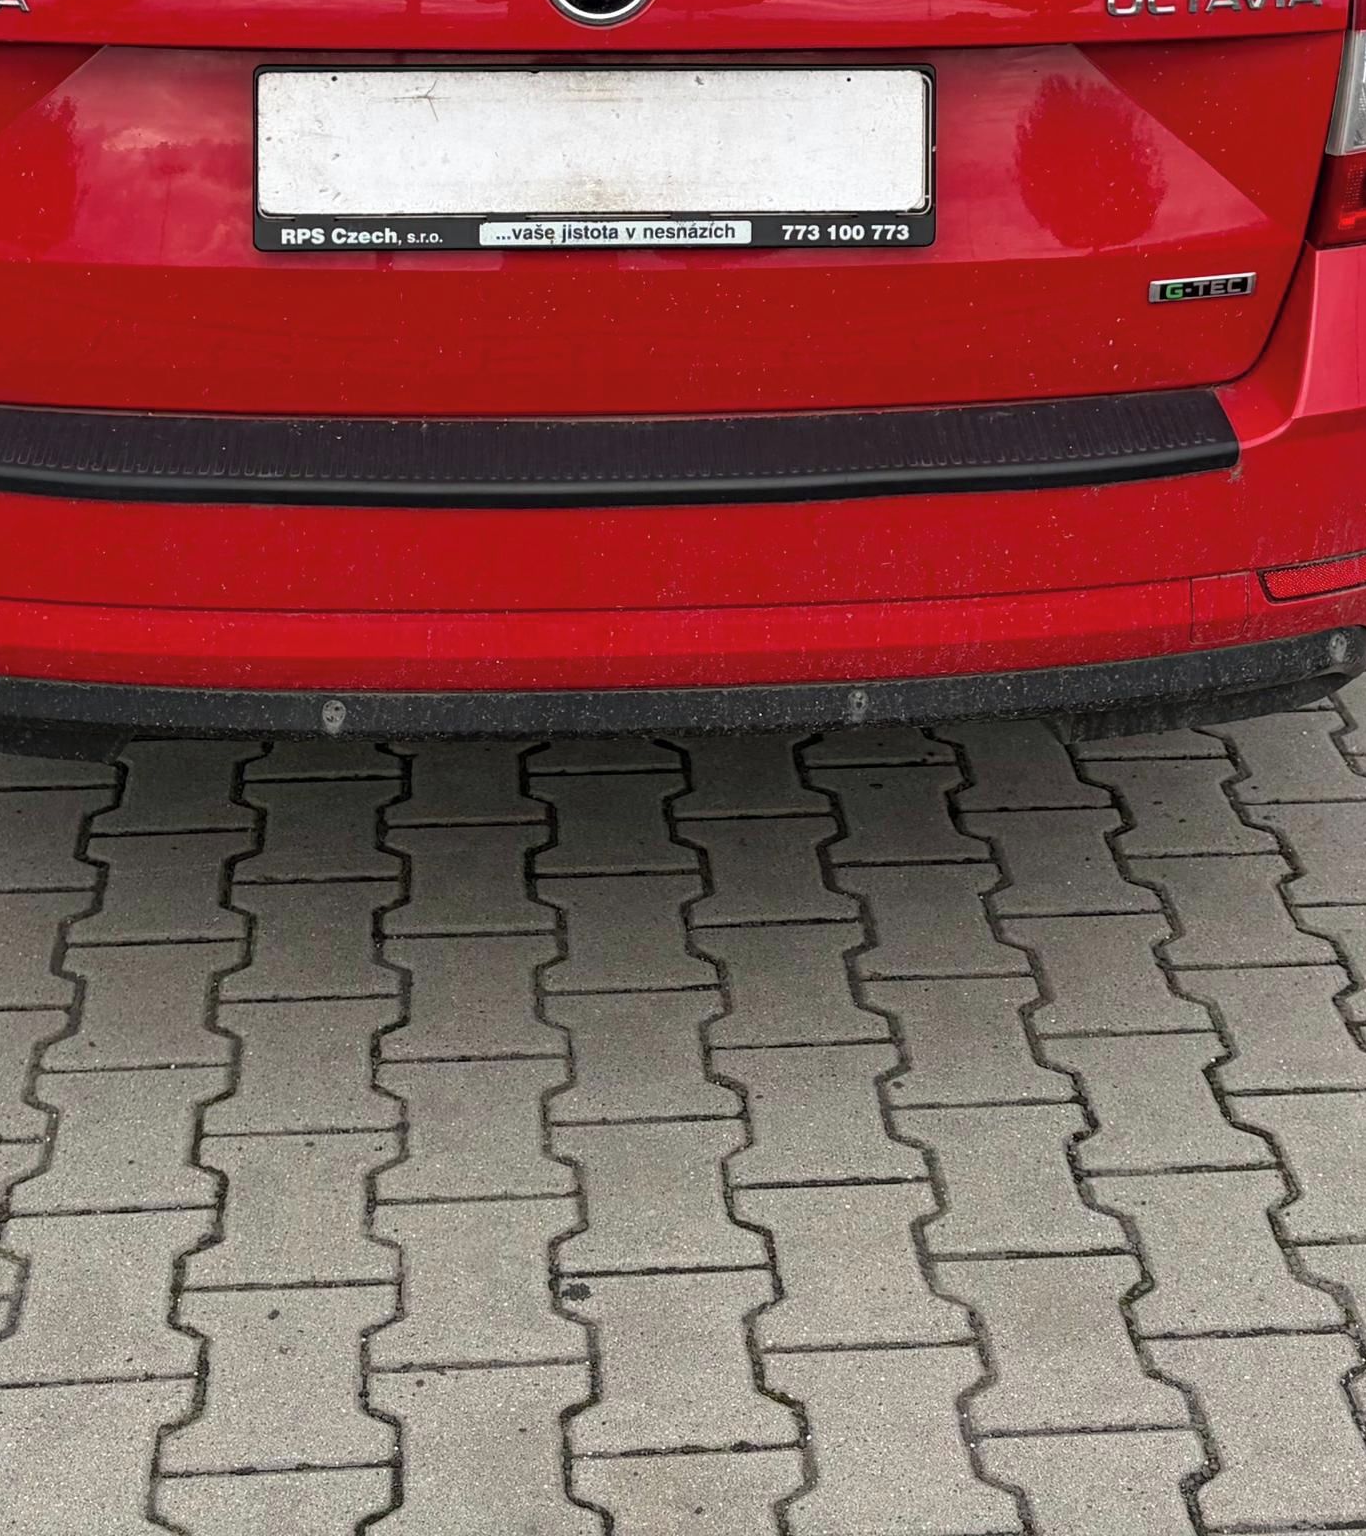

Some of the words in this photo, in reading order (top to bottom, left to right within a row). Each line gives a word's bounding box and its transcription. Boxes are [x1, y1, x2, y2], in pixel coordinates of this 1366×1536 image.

[281, 228, 325, 245] RPS
[331, 227, 403, 246] Czech,
[407, 233, 443, 243] s.r.o.
[561, 224, 619, 243] jistota
[626, 228, 636, 239] v
[643, 222, 736, 239] nesnázích
[782, 225, 820, 240] 773
[827, 225, 865, 240] 100
[871, 225, 910, 240] 773
[1166, 278, 1243, 299] G-TEC
